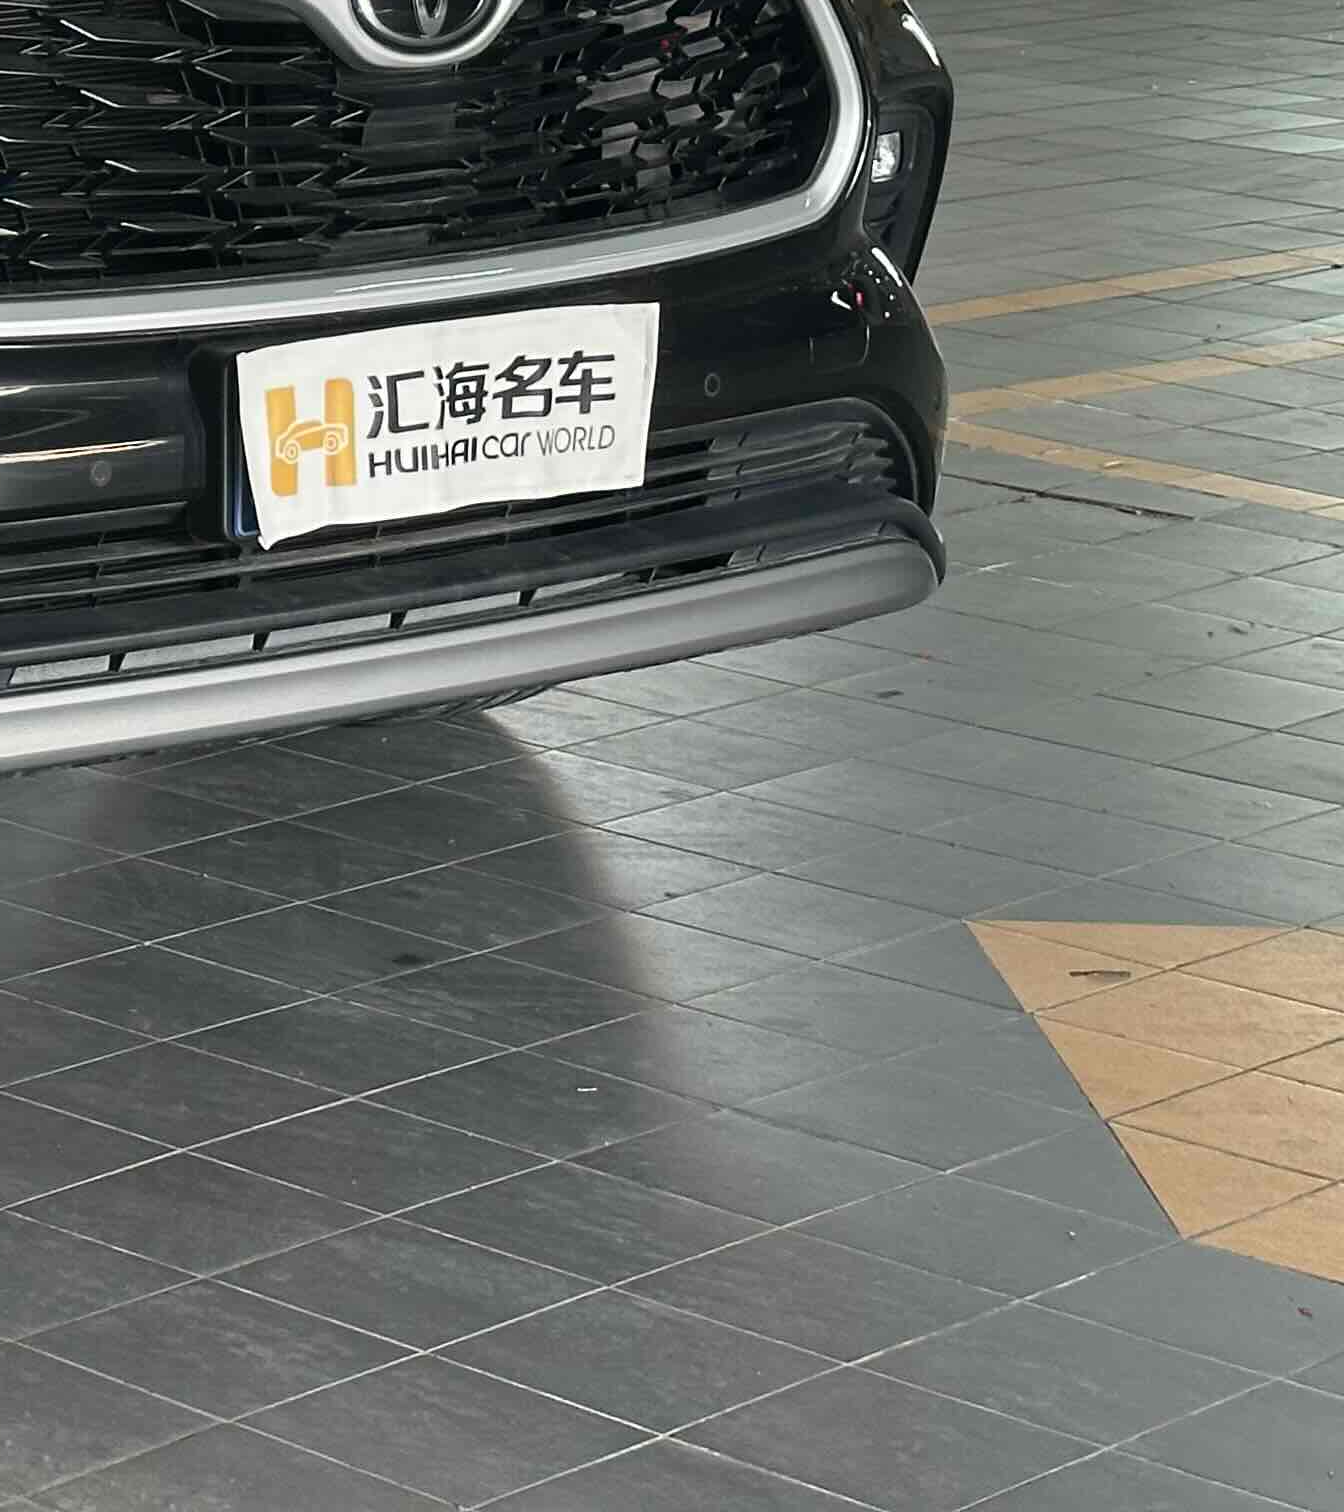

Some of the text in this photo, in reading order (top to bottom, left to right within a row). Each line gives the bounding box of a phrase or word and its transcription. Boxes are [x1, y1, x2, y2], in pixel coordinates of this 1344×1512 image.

[366, 350, 616, 439] 汇海名车
[368, 437, 478, 478] HUIHAI
[537, 424, 616, 458] WORLD
